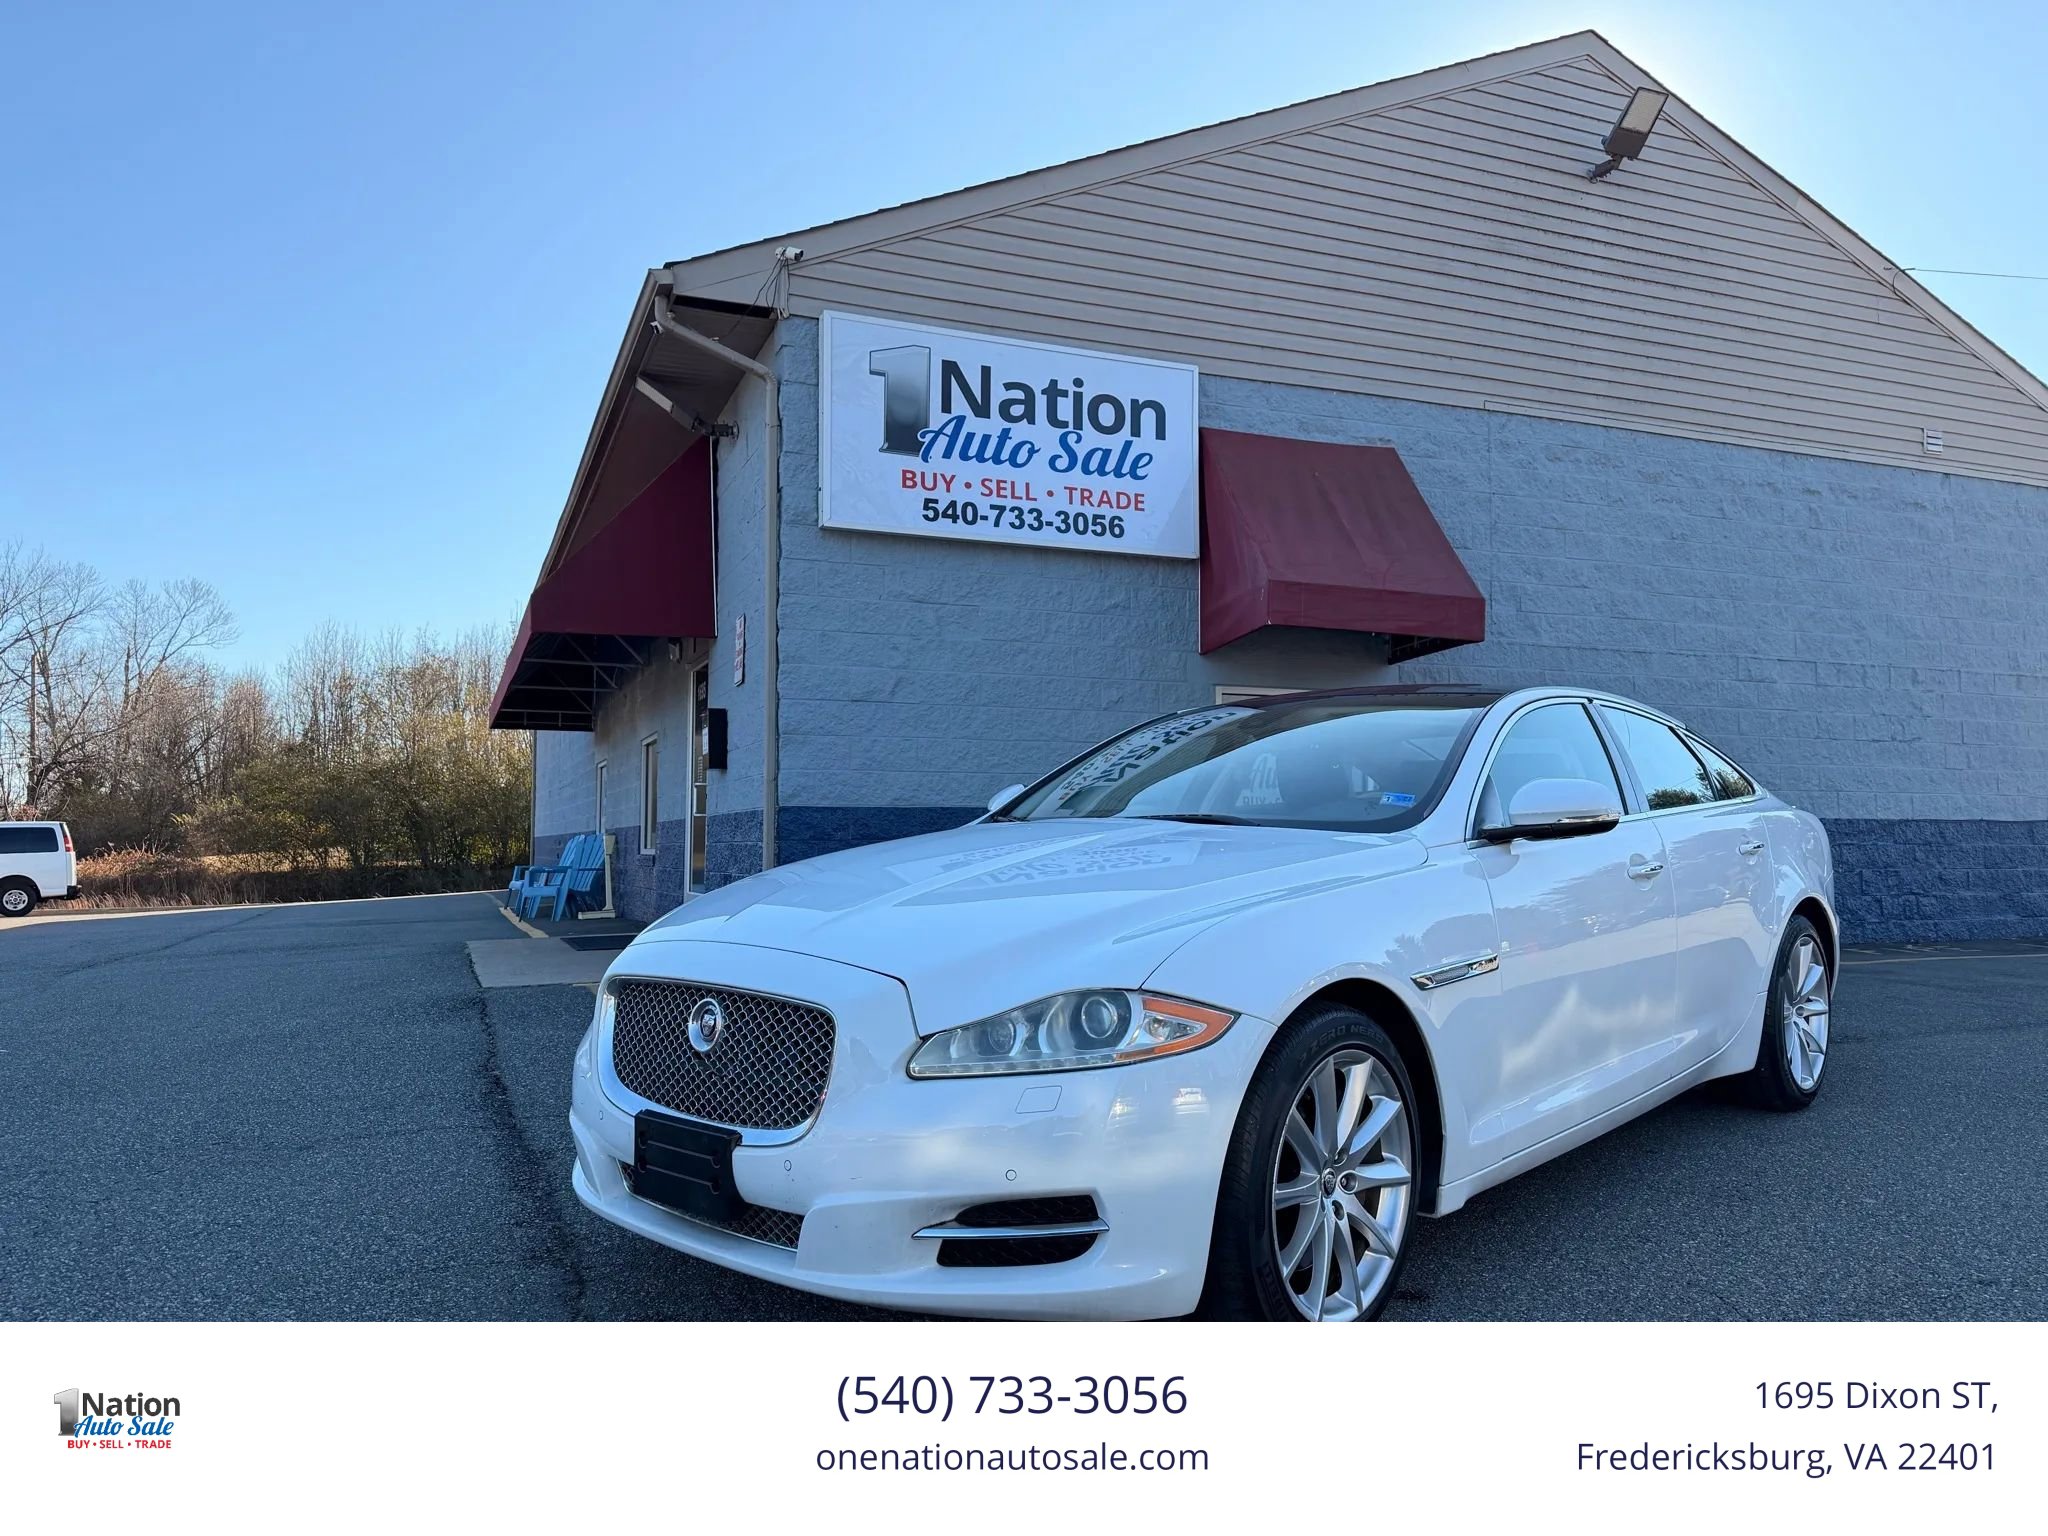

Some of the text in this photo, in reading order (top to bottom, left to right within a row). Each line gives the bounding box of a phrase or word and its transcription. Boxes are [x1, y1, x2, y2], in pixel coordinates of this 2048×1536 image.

[941, 358, 1167, 441] Nation
[917, 415, 1154, 481] Auto Sale
[901, 468, 1146, 512] BUY SELL TRADE
[922, 497, 1125, 539] 540-733-3056
